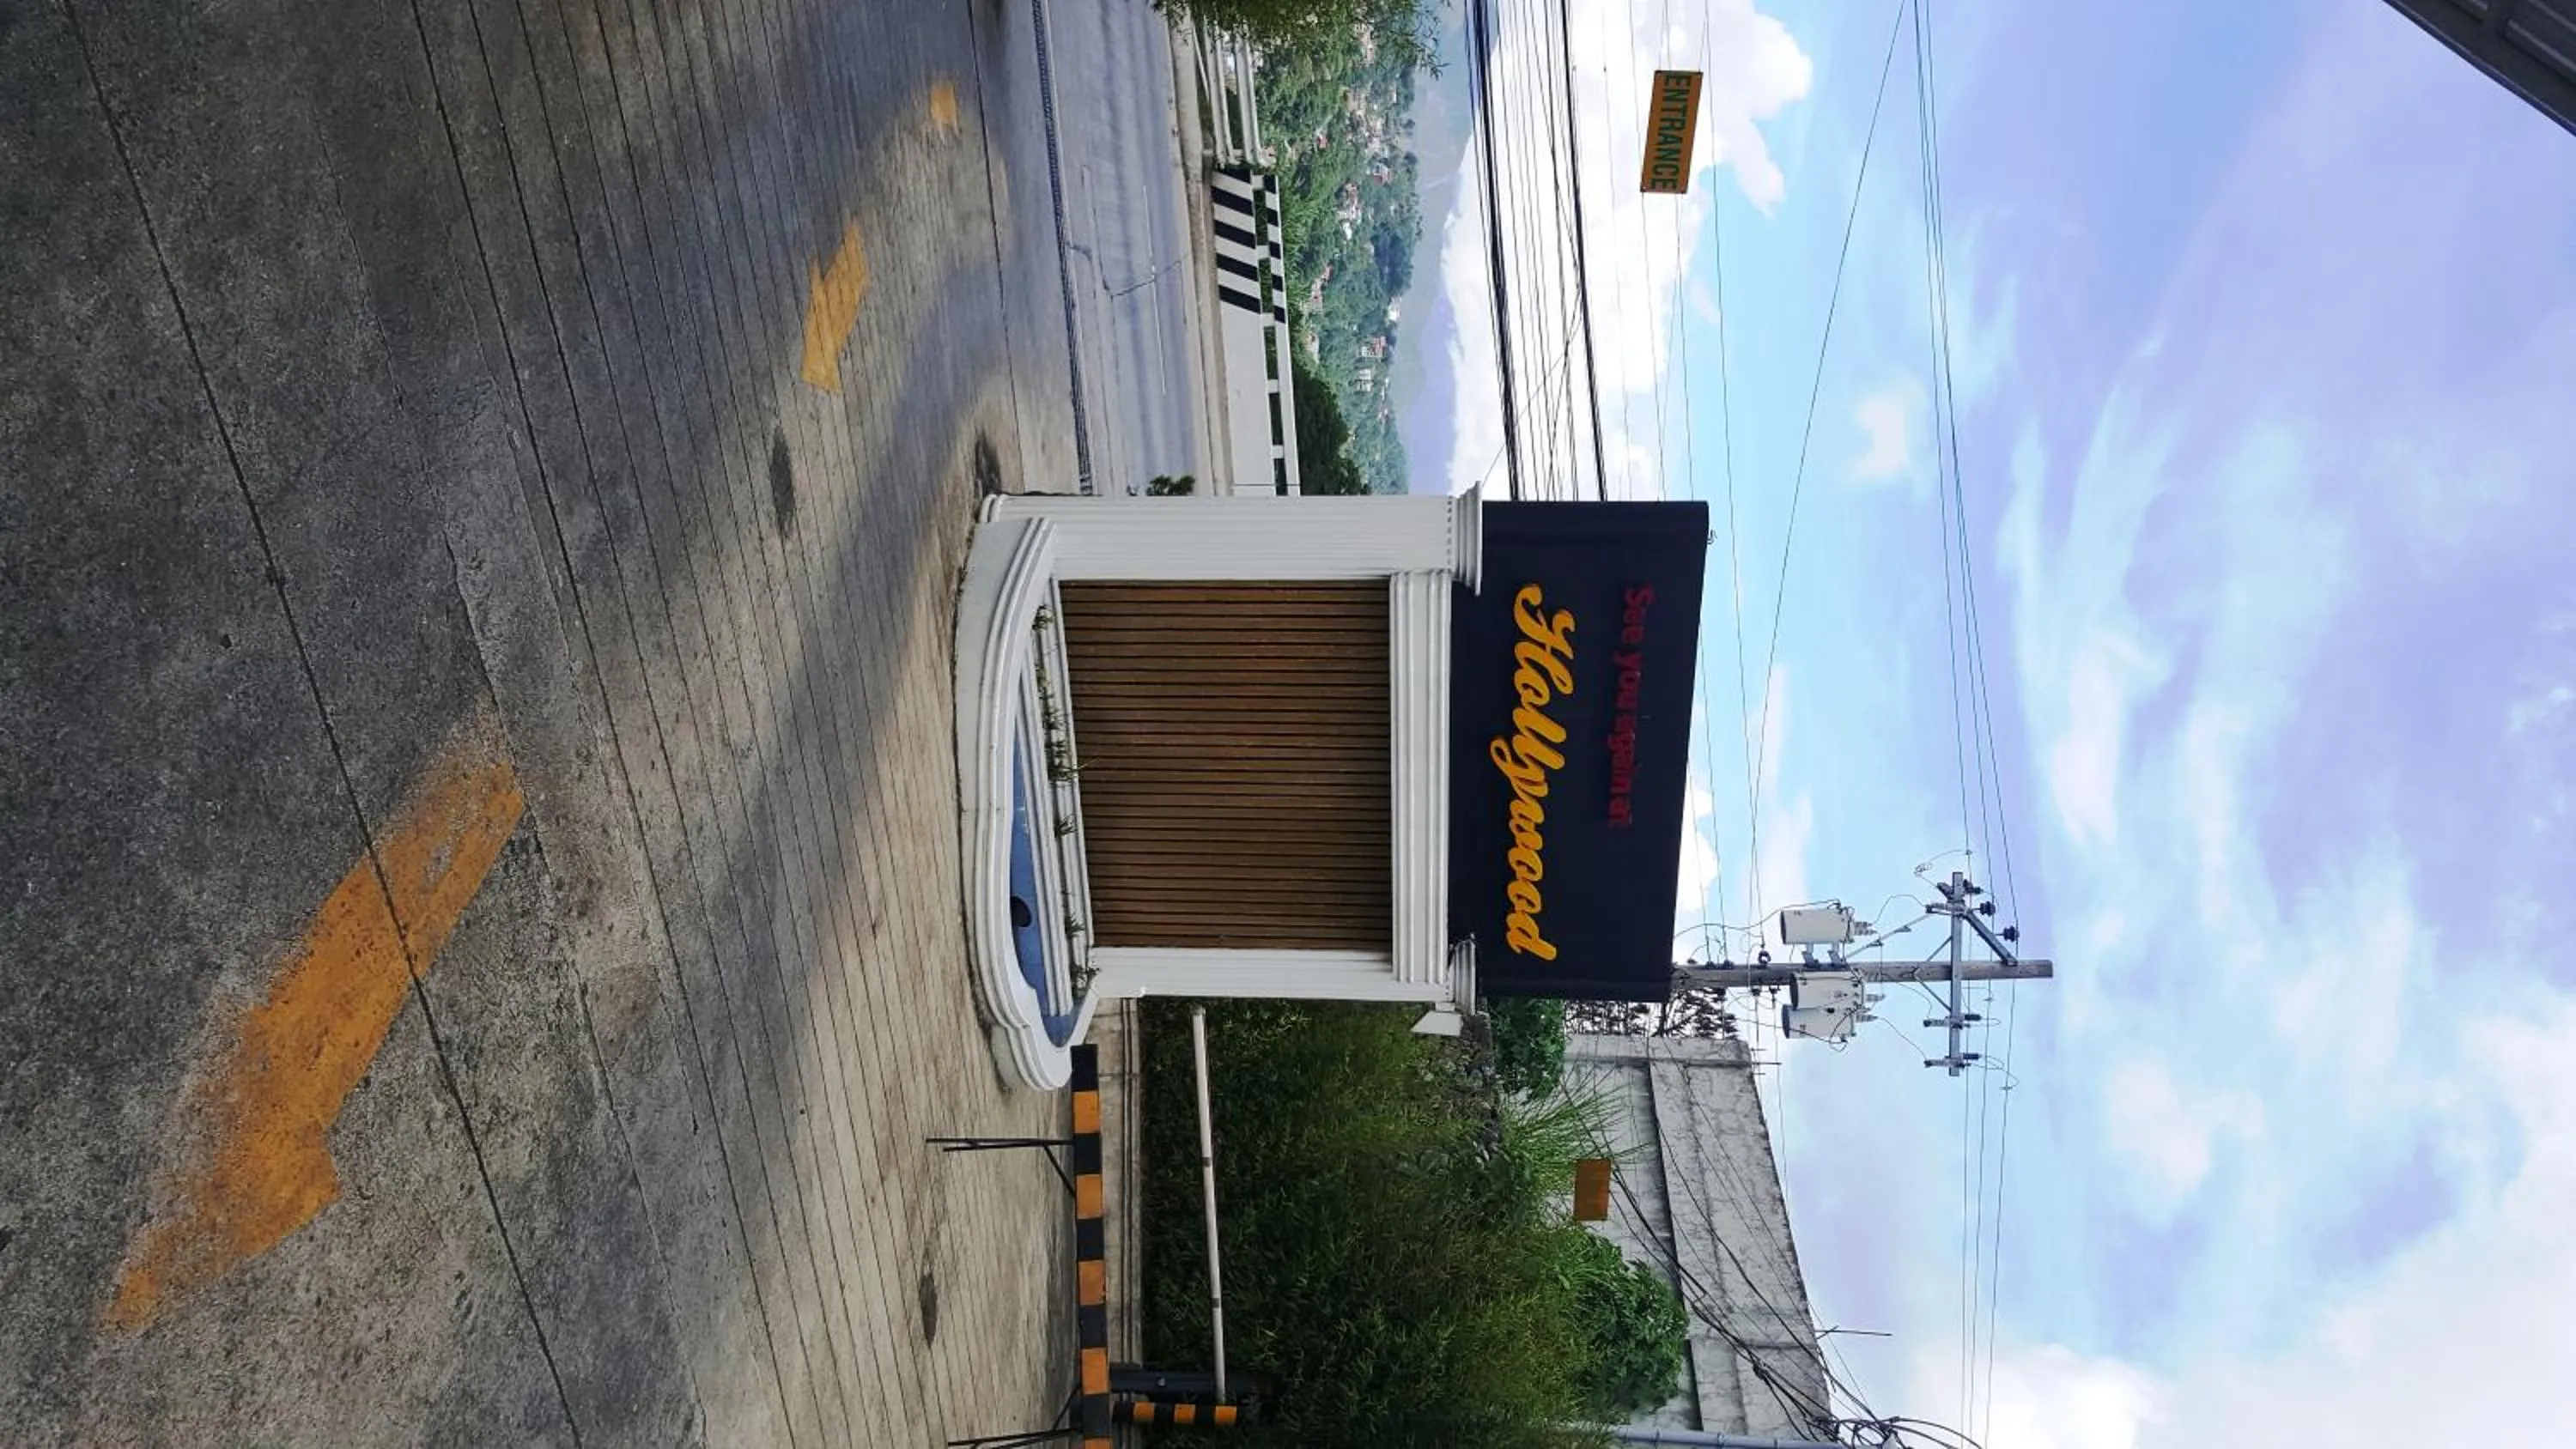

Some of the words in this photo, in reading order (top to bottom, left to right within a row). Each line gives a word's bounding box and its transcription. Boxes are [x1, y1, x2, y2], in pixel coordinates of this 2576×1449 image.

[1650, 75, 1692, 190] ENTRANCE
[1622, 584, 1654, 646] See
[1612, 651, 1643, 710] you
[1490, 584, 1576, 961] Hollywood
[1607, 712, 1637, 794] again
[1608, 795, 1633, 828] at
